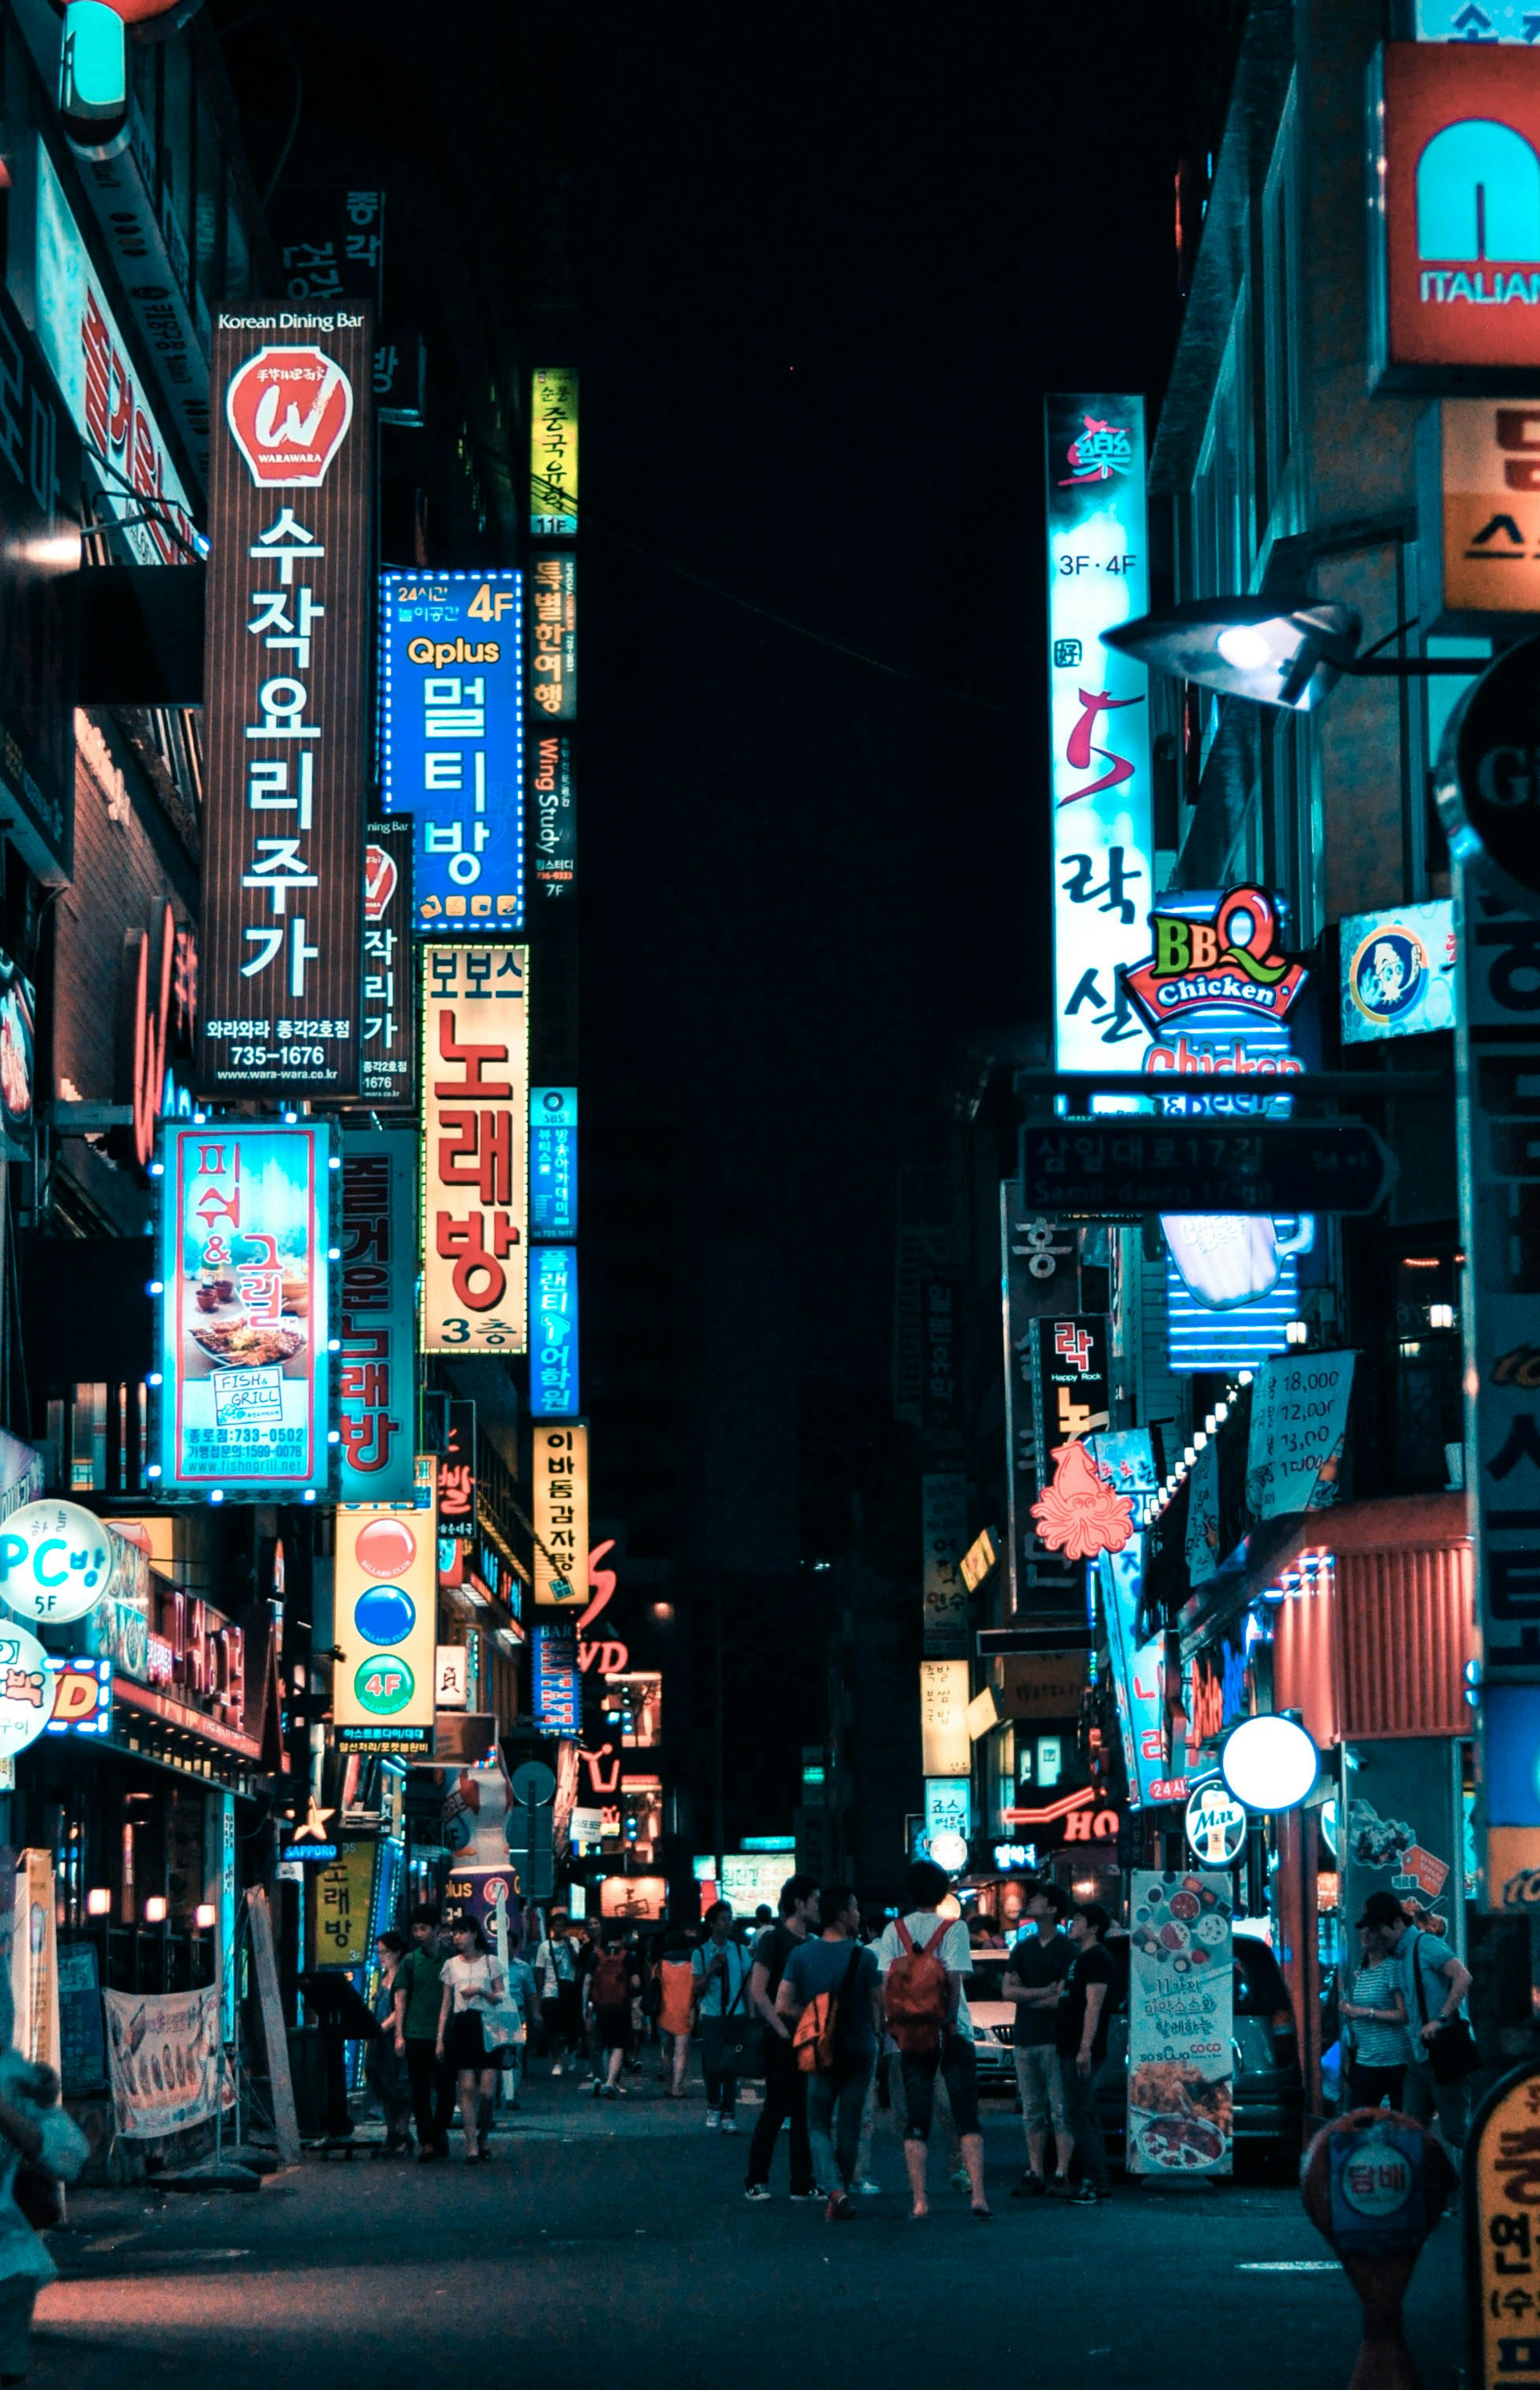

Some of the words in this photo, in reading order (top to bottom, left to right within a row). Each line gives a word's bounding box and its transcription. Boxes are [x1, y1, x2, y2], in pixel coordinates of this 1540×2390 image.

[219, 314, 276, 329] Korean
[279, 314, 334, 331] Dining
[337, 313, 364, 328] Bar
[257, 453, 322, 463] WARAWARA
[537, 517, 568, 534] 11F
[398, 586, 448, 602] 24시간
[467, 583, 514, 623] 4F
[407, 636, 501, 669] Qplus
[240, 508, 326, 998] 수작요리주가
[535, 737, 559, 791] Wing
[423, 676, 492, 886] 멀티방
[367, 822, 391, 833] ning
[391, 821, 409, 831] Bar
[535, 794, 559, 854] Study
[545, 883, 565, 899] 7F
[1152, 887, 1287, 983] BBQ
[430, 952, 524, 1000] 보보스
[1157, 977, 1276, 1008] Chicken
[206, 1020, 270, 1039] 와라와라
[276, 1020, 351, 1040] 종각2호점
[231, 1045, 325, 1067] 735-1676
[217, 1069, 338, 1081] www.wara-wara.co.kr
[363, 1060, 407, 1073] 종각2호점
[363, 1077, 392, 1089] -1676
[544, 1114, 564, 1123] SBS
[432, 1008, 521, 1314] 노래방
[237, 1233, 283, 1328] 그릴
[440, 1317, 518, 1346] 3층
[1054, 1322, 1094, 1372] 락
[221, 1373, 261, 1389] FISH
[537, 1345, 569, 1413] 어학원
[1051, 1373, 1078, 1382] Happy
[1080, 1373, 1103, 1381] Rock
[1283, 1370, 1339, 1393] 18,000
[231, 1390, 278, 1406] GRILL
[188, 1427, 304, 1444] 종로점:733-0502
[188, 1444, 302, 1459] 가맹점문의:1599-0078
[188, 1460, 302, 1474] www.fishngrill.net
[391, 1559, 411, 1576] CLUB
[34, 1595, 58, 1614] 5F
[391, 1626, 411, 1643] CLUB
[364, 1674, 402, 1696] 4F
[390, 1694, 411, 1713] CLUB
[931, 1800, 961, 1814] 죠스
[1194, 1809, 1234, 1837] Max
[285, 1844, 337, 1857] SAPPORO
